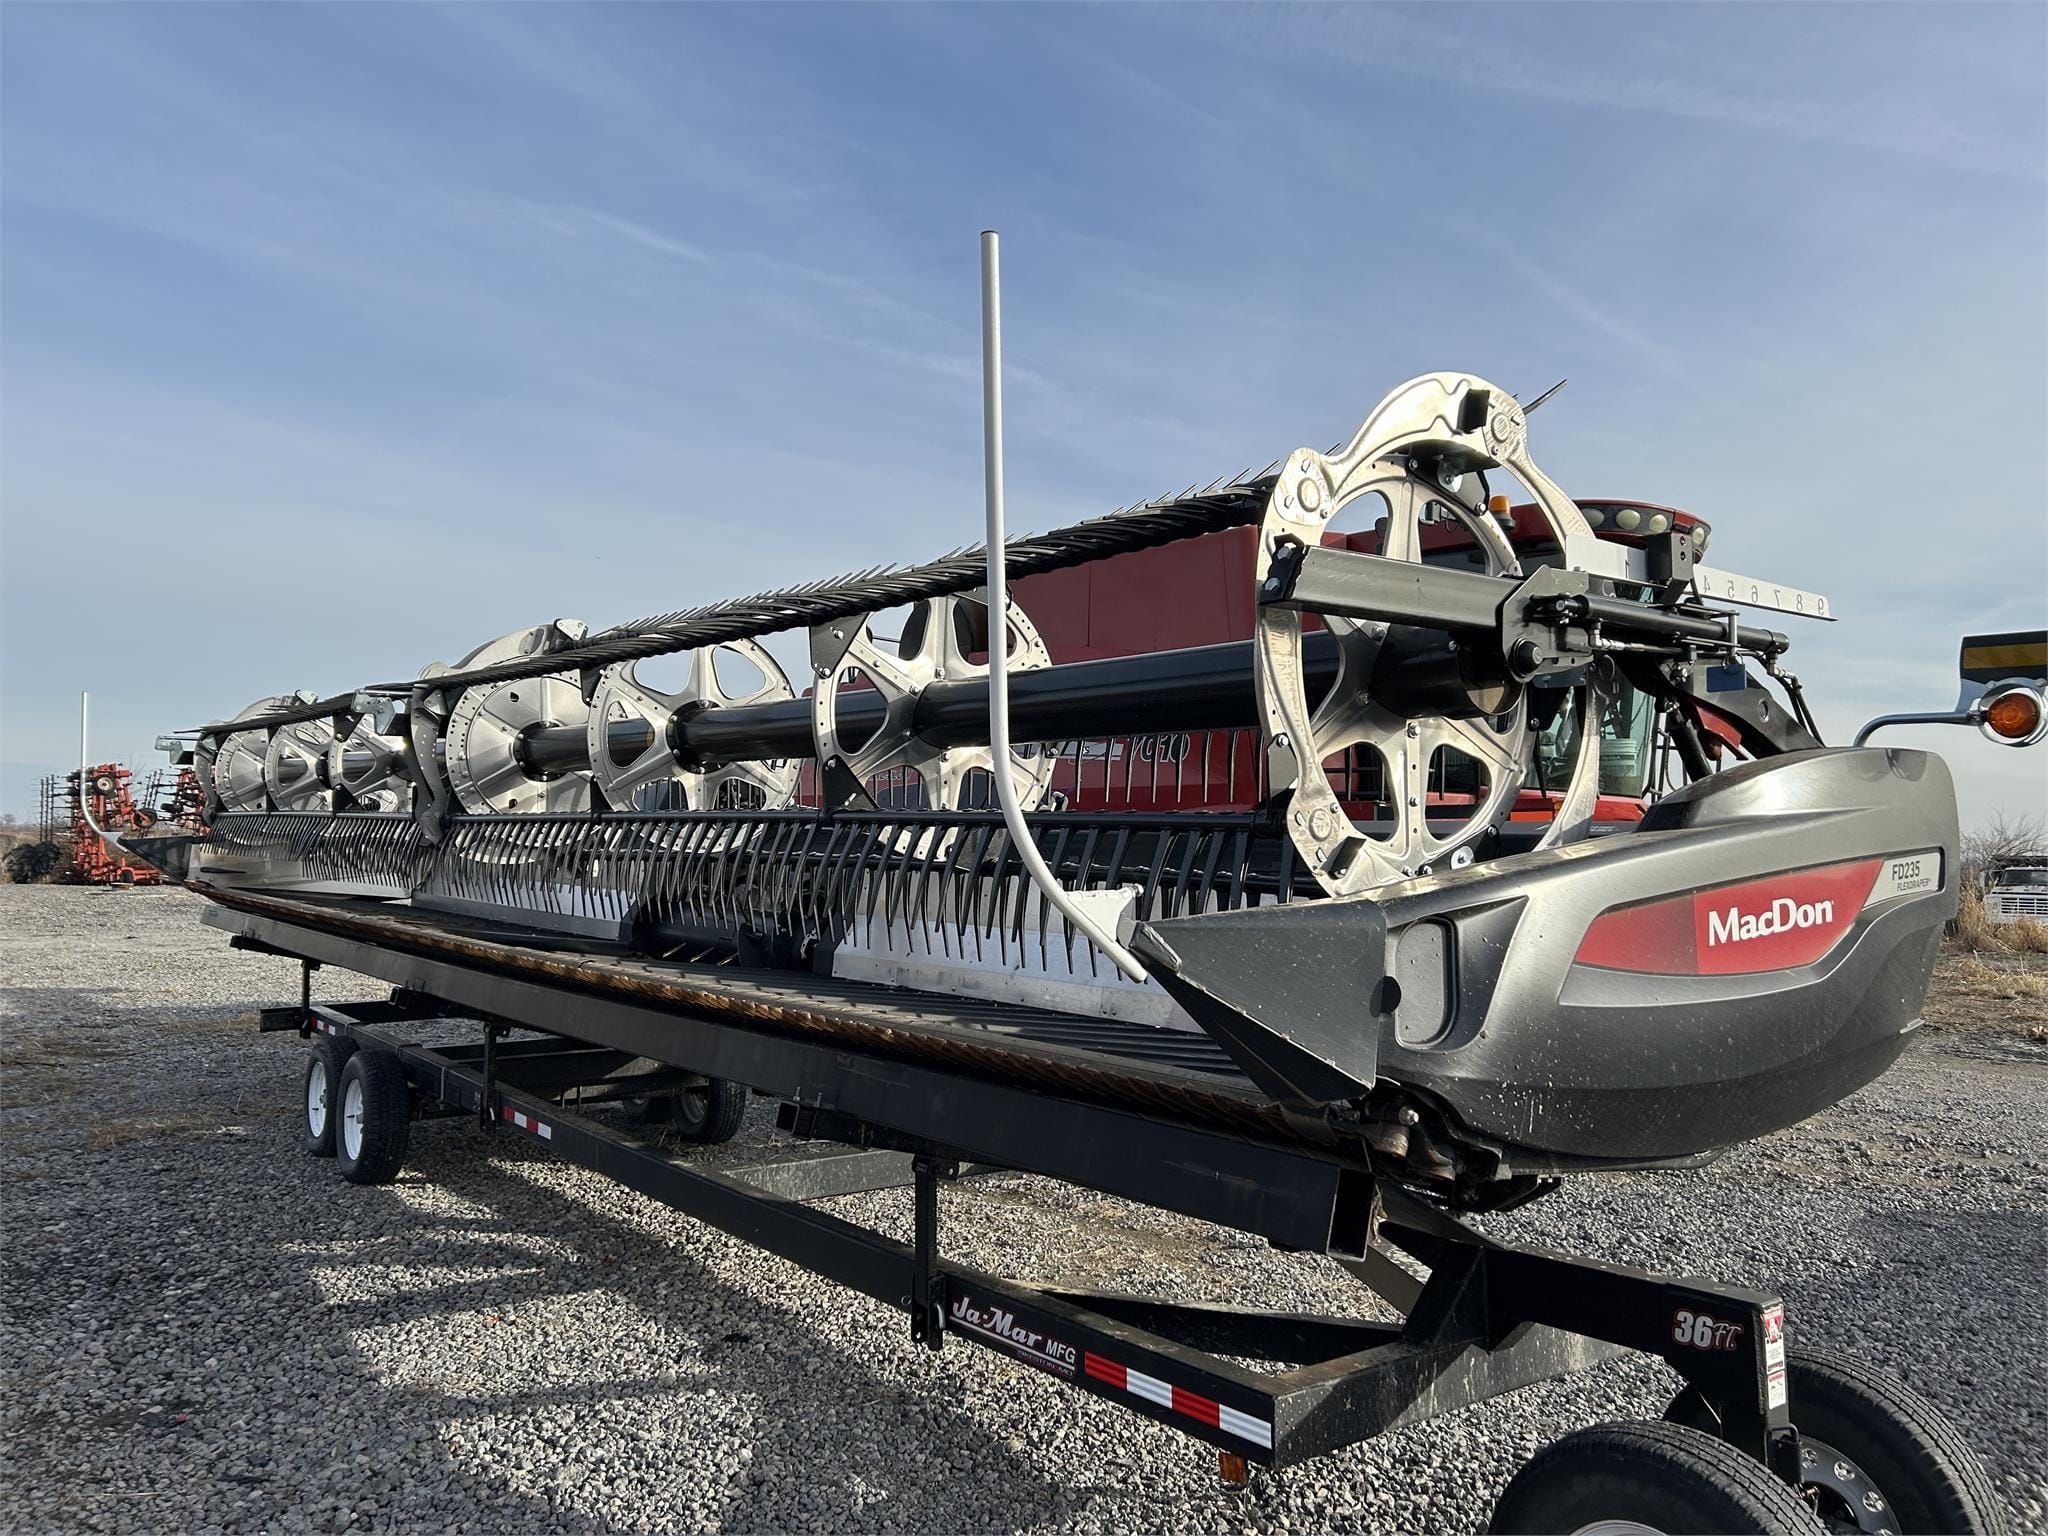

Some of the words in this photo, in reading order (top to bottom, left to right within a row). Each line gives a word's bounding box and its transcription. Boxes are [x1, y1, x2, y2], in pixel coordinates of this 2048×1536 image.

[1891, 860, 1921, 881] FD235
[1708, 897, 1833, 947] MacDon
[1045, 1338, 1076, 1364] MFG
